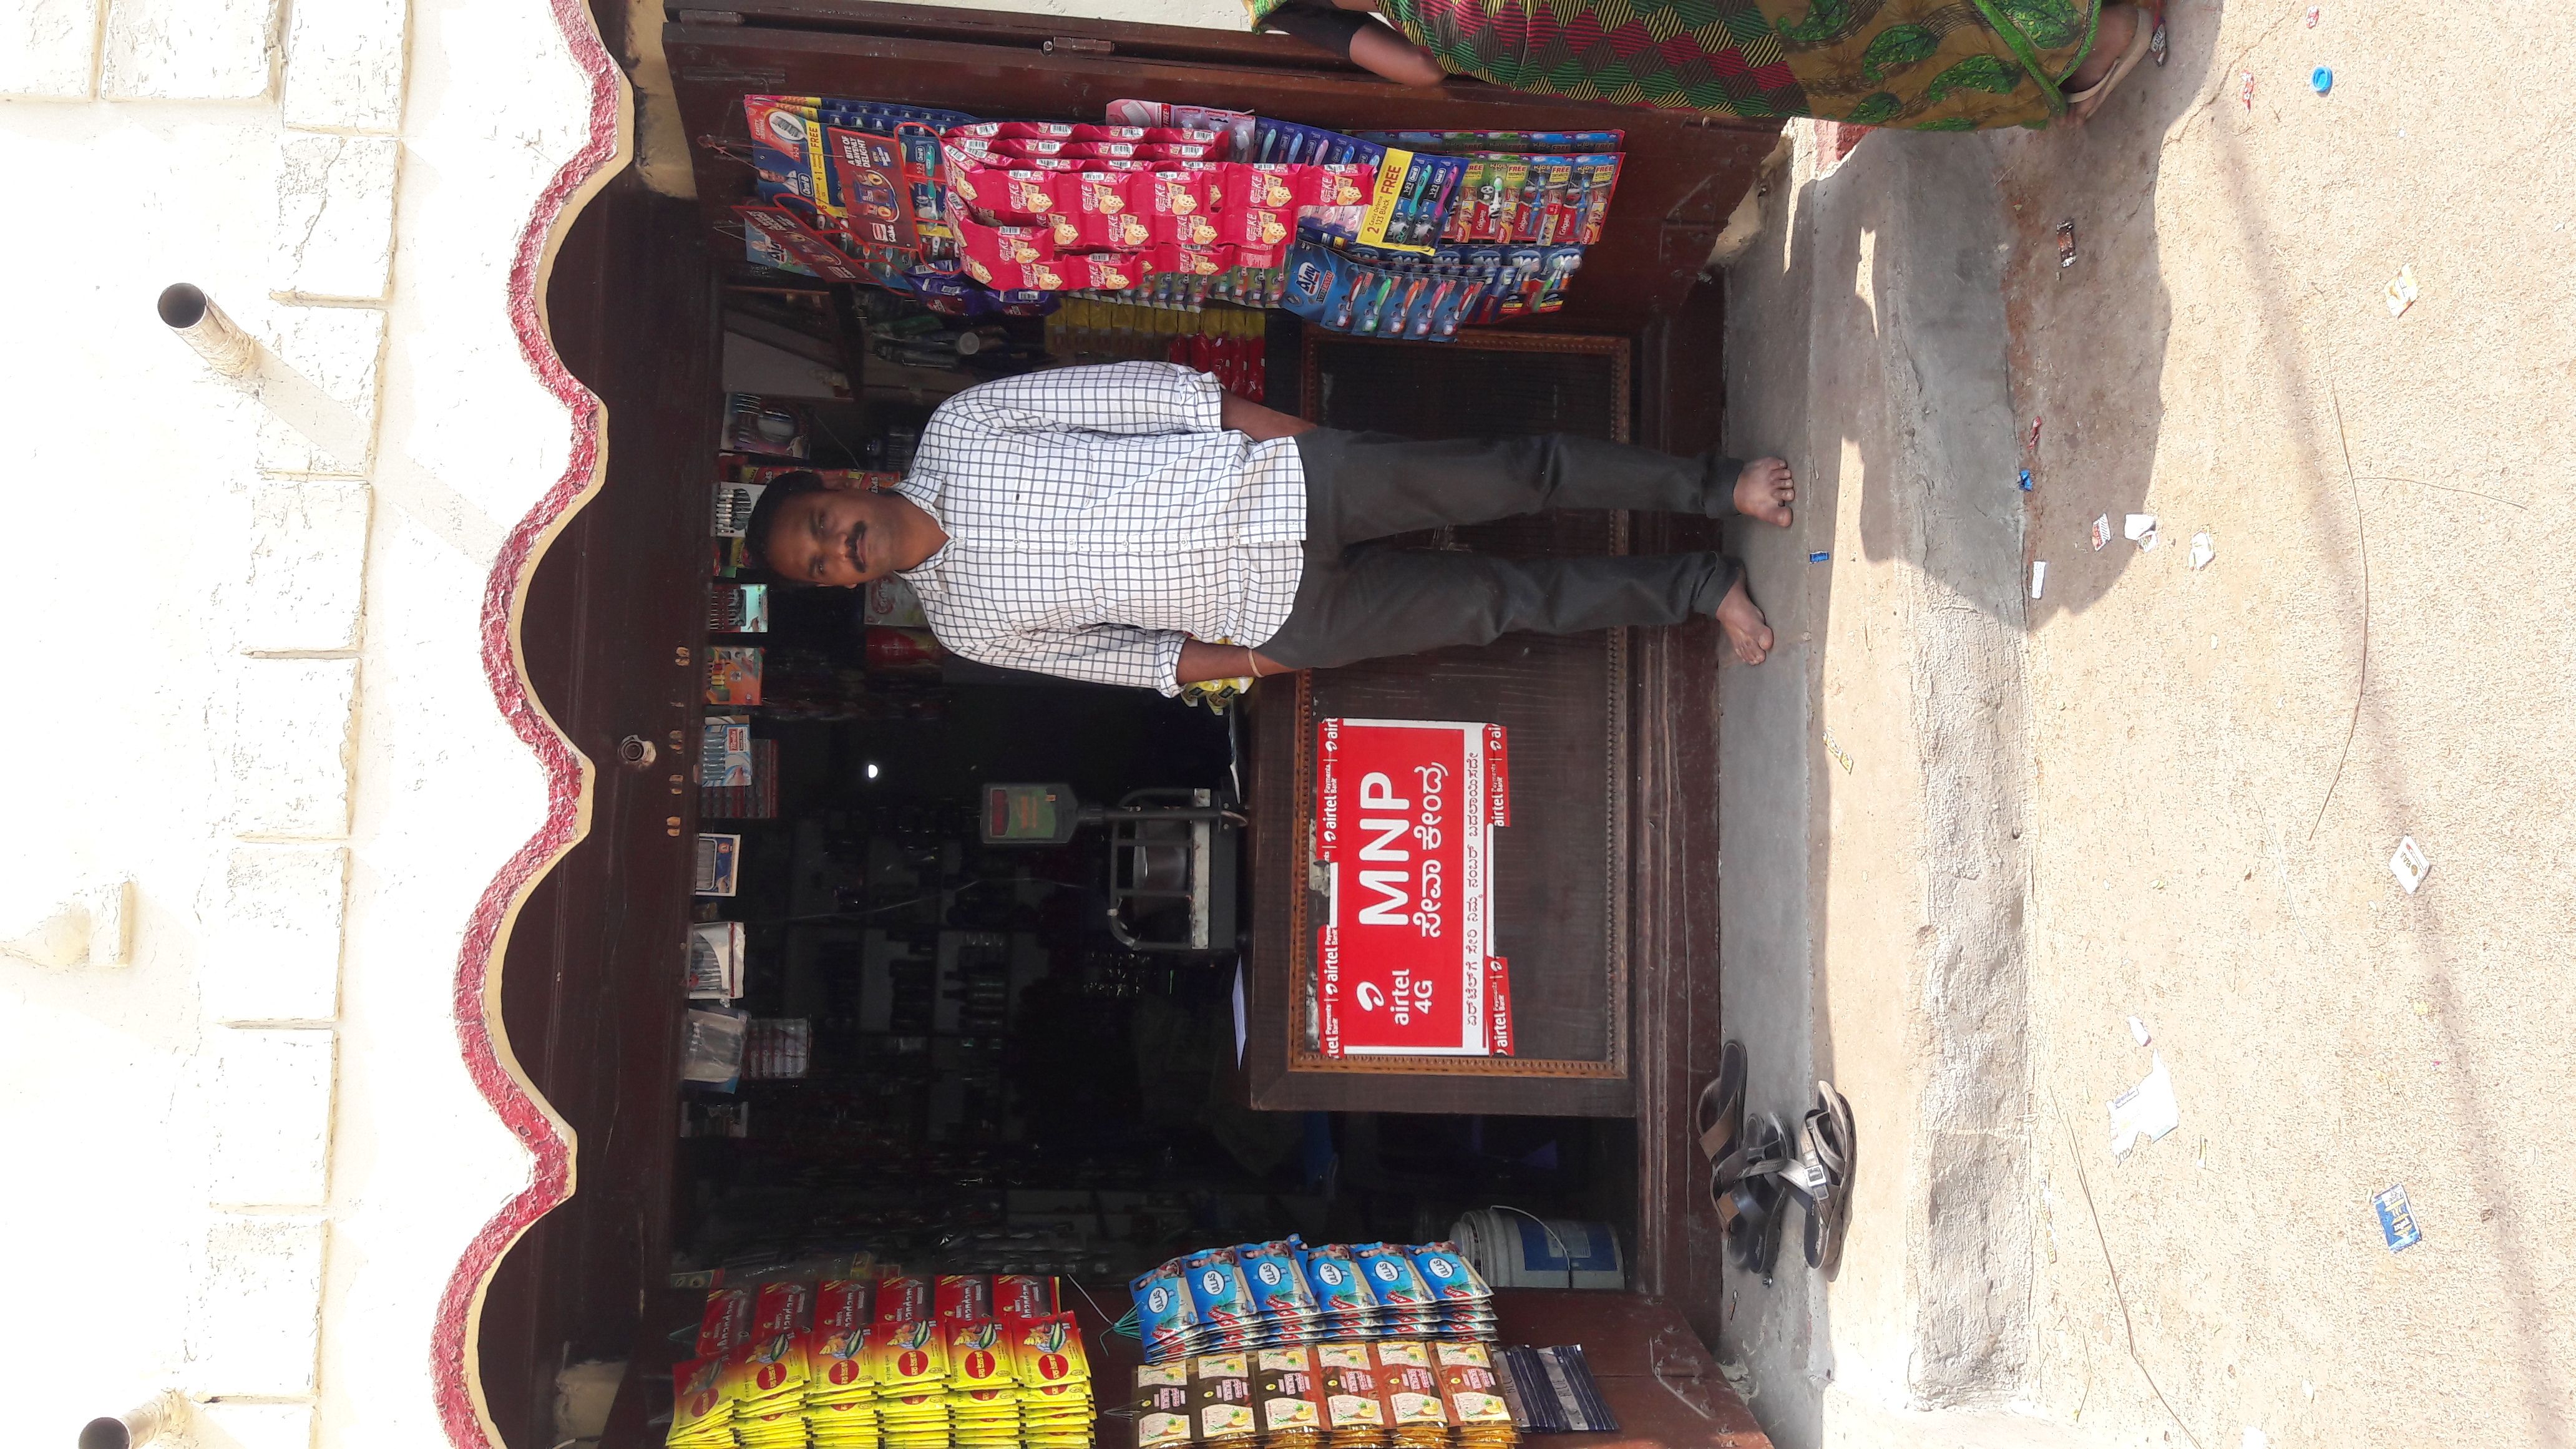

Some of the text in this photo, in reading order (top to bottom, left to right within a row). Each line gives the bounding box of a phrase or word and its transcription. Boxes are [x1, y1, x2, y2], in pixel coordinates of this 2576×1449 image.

[809, 127, 819, 148] FREE
[841, 135, 850, 145] OF
[845, 145, 854, 159] BITE
[849, 137, 863, 167] HEAVENLY
[857, 139, 871, 167] DELIGHT
[801, 176, 811, 194] Oral-B
[1380, 165, 1402, 195] FREE
[1378, 199, 1390, 215] Black
[1036, 214, 1046, 227] KE
[1375, 216, 1384, 225] 123
[1559, 213, 1571, 235] Colgate
[1295, 265, 1321, 292] Ajay
[1323, 796, 1337, 829] airtel
[1491, 794, 1505, 827] airtel
[1358, 771, 1410, 925] MNP
[1413, 761, 1449, 937] ಸೇವಾ ಕೇಂದ್ರ
[1466, 844, 1478, 887] ನಂಬರ್
[1466, 894, 1483, 922] ನಿಮ್ಮ
[1465, 929, 1478, 954] ಸೇರಿ
[1324, 948, 1339, 981] airtel
[1390, 968, 1410, 1025] airtel
[1414, 979, 1433, 1014] 4G
[1493, 1013, 1508, 1048] airtel
[1264, 1264, 1276, 1284] ULLAS
[1324, 1266, 1339, 1283] ULLAS
[1379, 1263, 1395, 1280] ULLAS
[1434, 1258, 1447, 1276] ULLAS
[1209, 1273, 1220, 1293] ULLAS
[1020, 1284, 1032, 1318] Anandam
[1153, 1290, 1163, 1311] ULLAS
